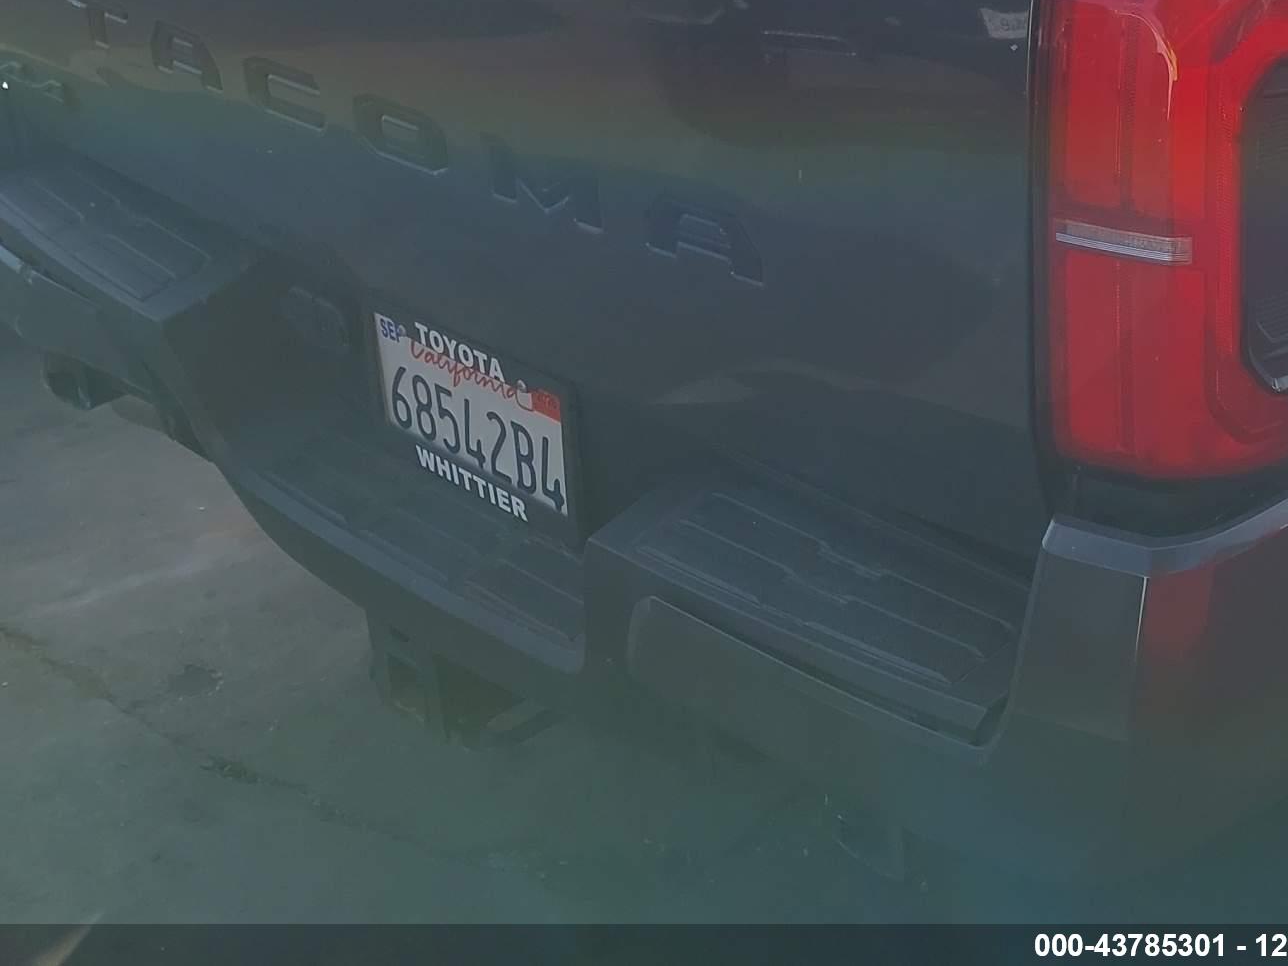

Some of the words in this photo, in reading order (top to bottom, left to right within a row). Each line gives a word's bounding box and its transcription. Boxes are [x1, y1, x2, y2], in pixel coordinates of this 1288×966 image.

[415, 321, 506, 382] TOYOTA
[391, 366, 566, 513] 68542B4
[415, 444, 529, 521] WHITTIER
